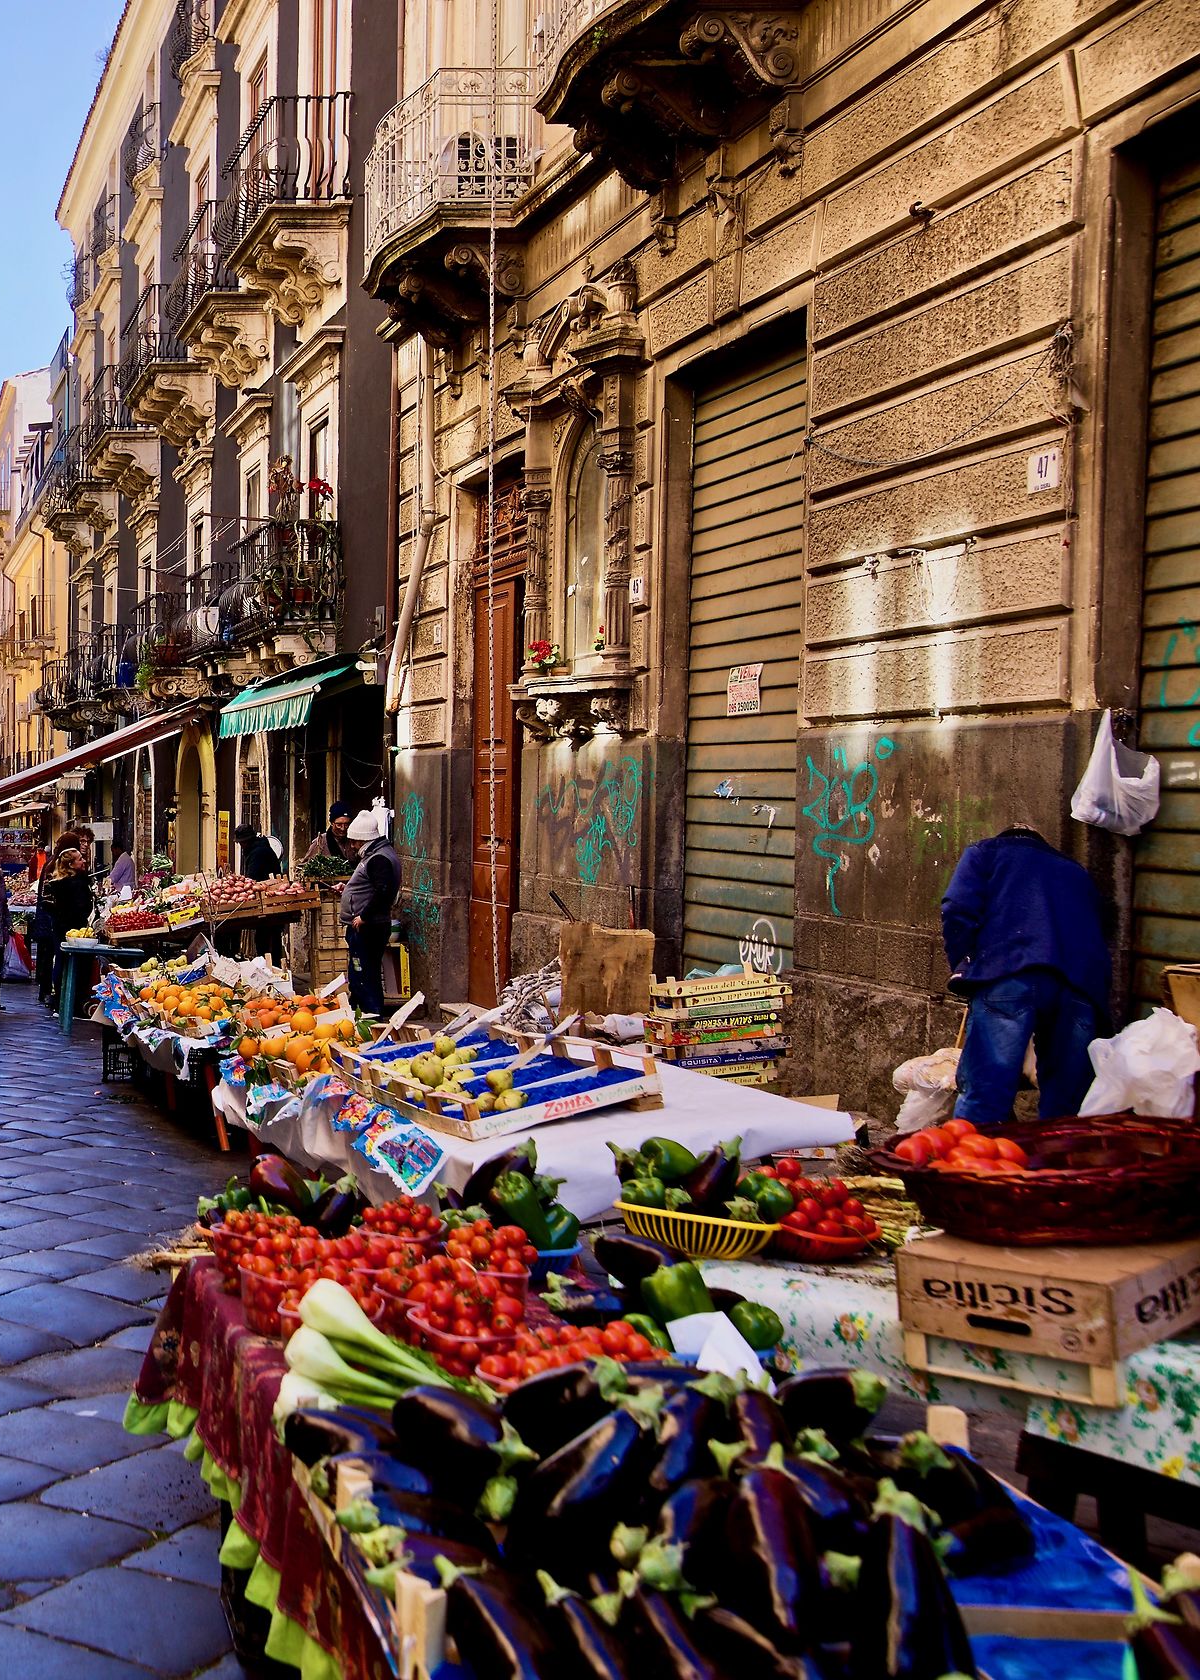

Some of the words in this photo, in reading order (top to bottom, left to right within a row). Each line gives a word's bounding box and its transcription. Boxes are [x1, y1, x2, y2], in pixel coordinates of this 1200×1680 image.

[1037, 455, 1049, 478] 47
[737, 700, 759, 712] 2500250
[694, 1020, 724, 1028] SERGIO
[729, 1016, 752, 1026] SALVA
[681, 1058, 719, 1066] SQUISITA
[544, 1094, 594, 1119] Zonta
[922, 1278, 1075, 1316] Sicilia
